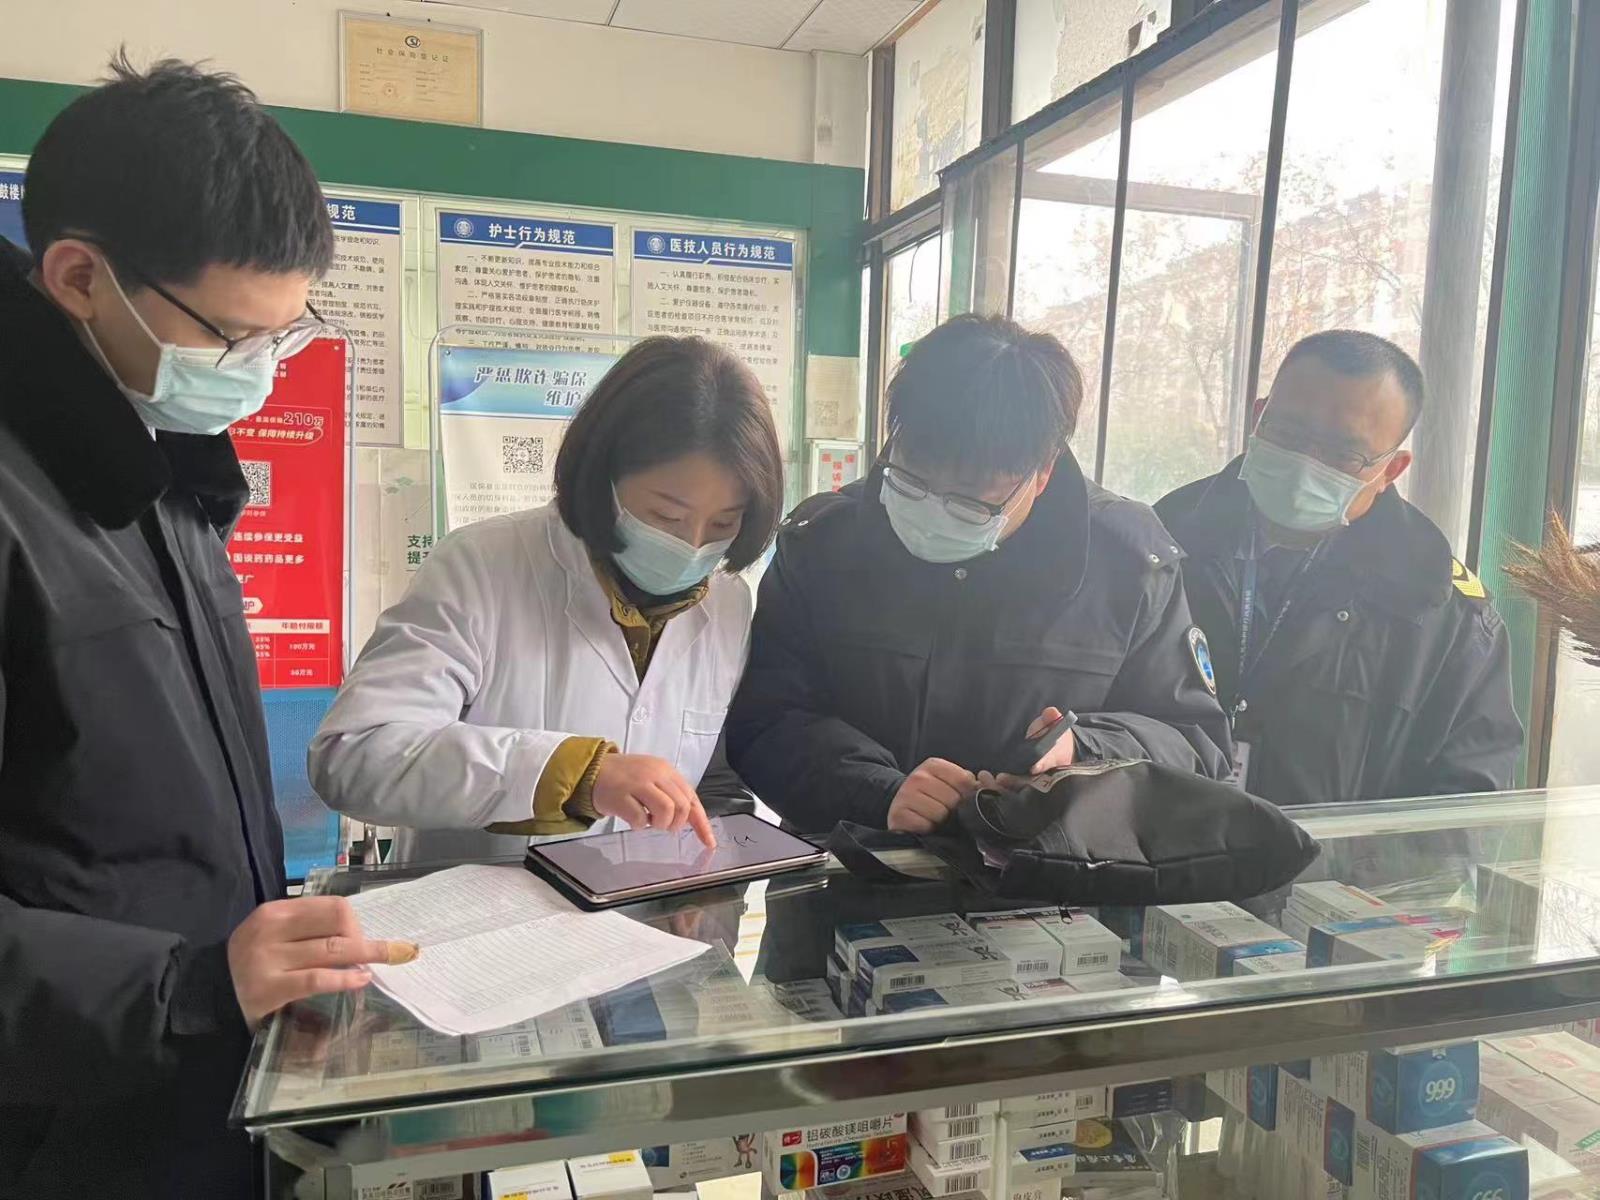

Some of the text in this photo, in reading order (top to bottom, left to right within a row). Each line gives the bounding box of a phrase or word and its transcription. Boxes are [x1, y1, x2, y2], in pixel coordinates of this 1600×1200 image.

[489, 222, 576, 244] 护士行为规范
[670, 239, 776, 259] 医技人员行为规范
[475, 365, 588, 387] 严惩欺诈骗保
[544, 389, 582, 407] 维护
[1424, 1077, 1457, 1103] 999
[807, 1116, 894, 1143] 铝碳酸镁咀嚼片
